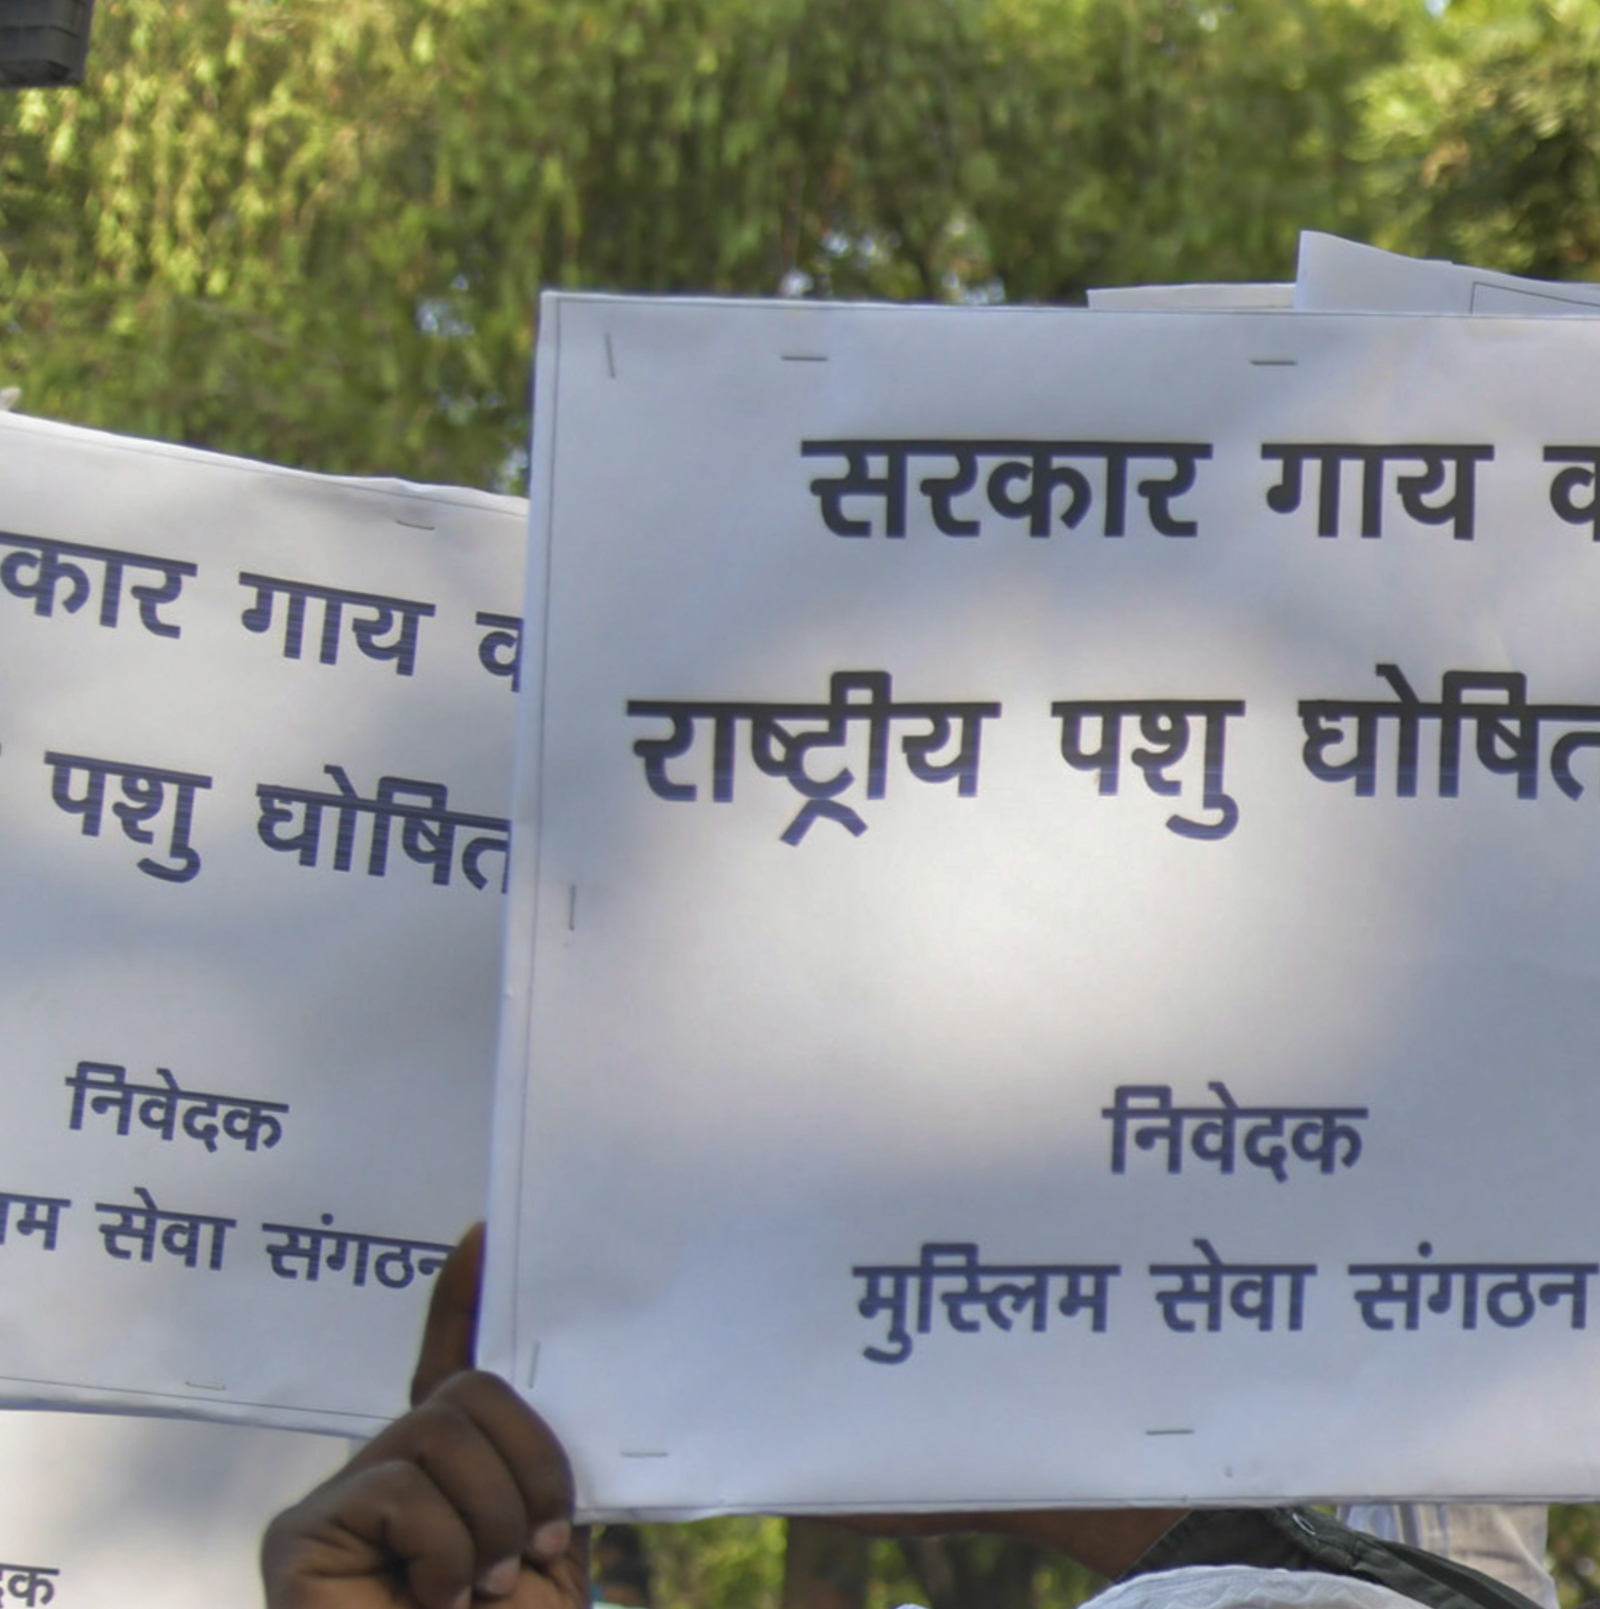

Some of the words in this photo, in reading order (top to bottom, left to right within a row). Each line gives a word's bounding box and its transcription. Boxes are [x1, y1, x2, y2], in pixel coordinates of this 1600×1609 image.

[800, 438, 1213, 538] सरकार
[1261, 443, 1495, 541] गाय
[239, 571, 436, 676] गाय
[626, 670, 1002, 846] राष्ट्रीय
[1051, 699, 1246, 841] पशु
[44, 751, 212, 883] पशु
[65, 1061, 289, 1152] निवेदक
[1102, 1082, 1368, 1183] निवेदक
[95, 1187, 236, 1270] सेवा
[852, 1243, 1120, 1364] मुस्लिम
[1149, 1239, 1317, 1332] सेवा
[1348, 1242, 1599, 1330] संगठन
